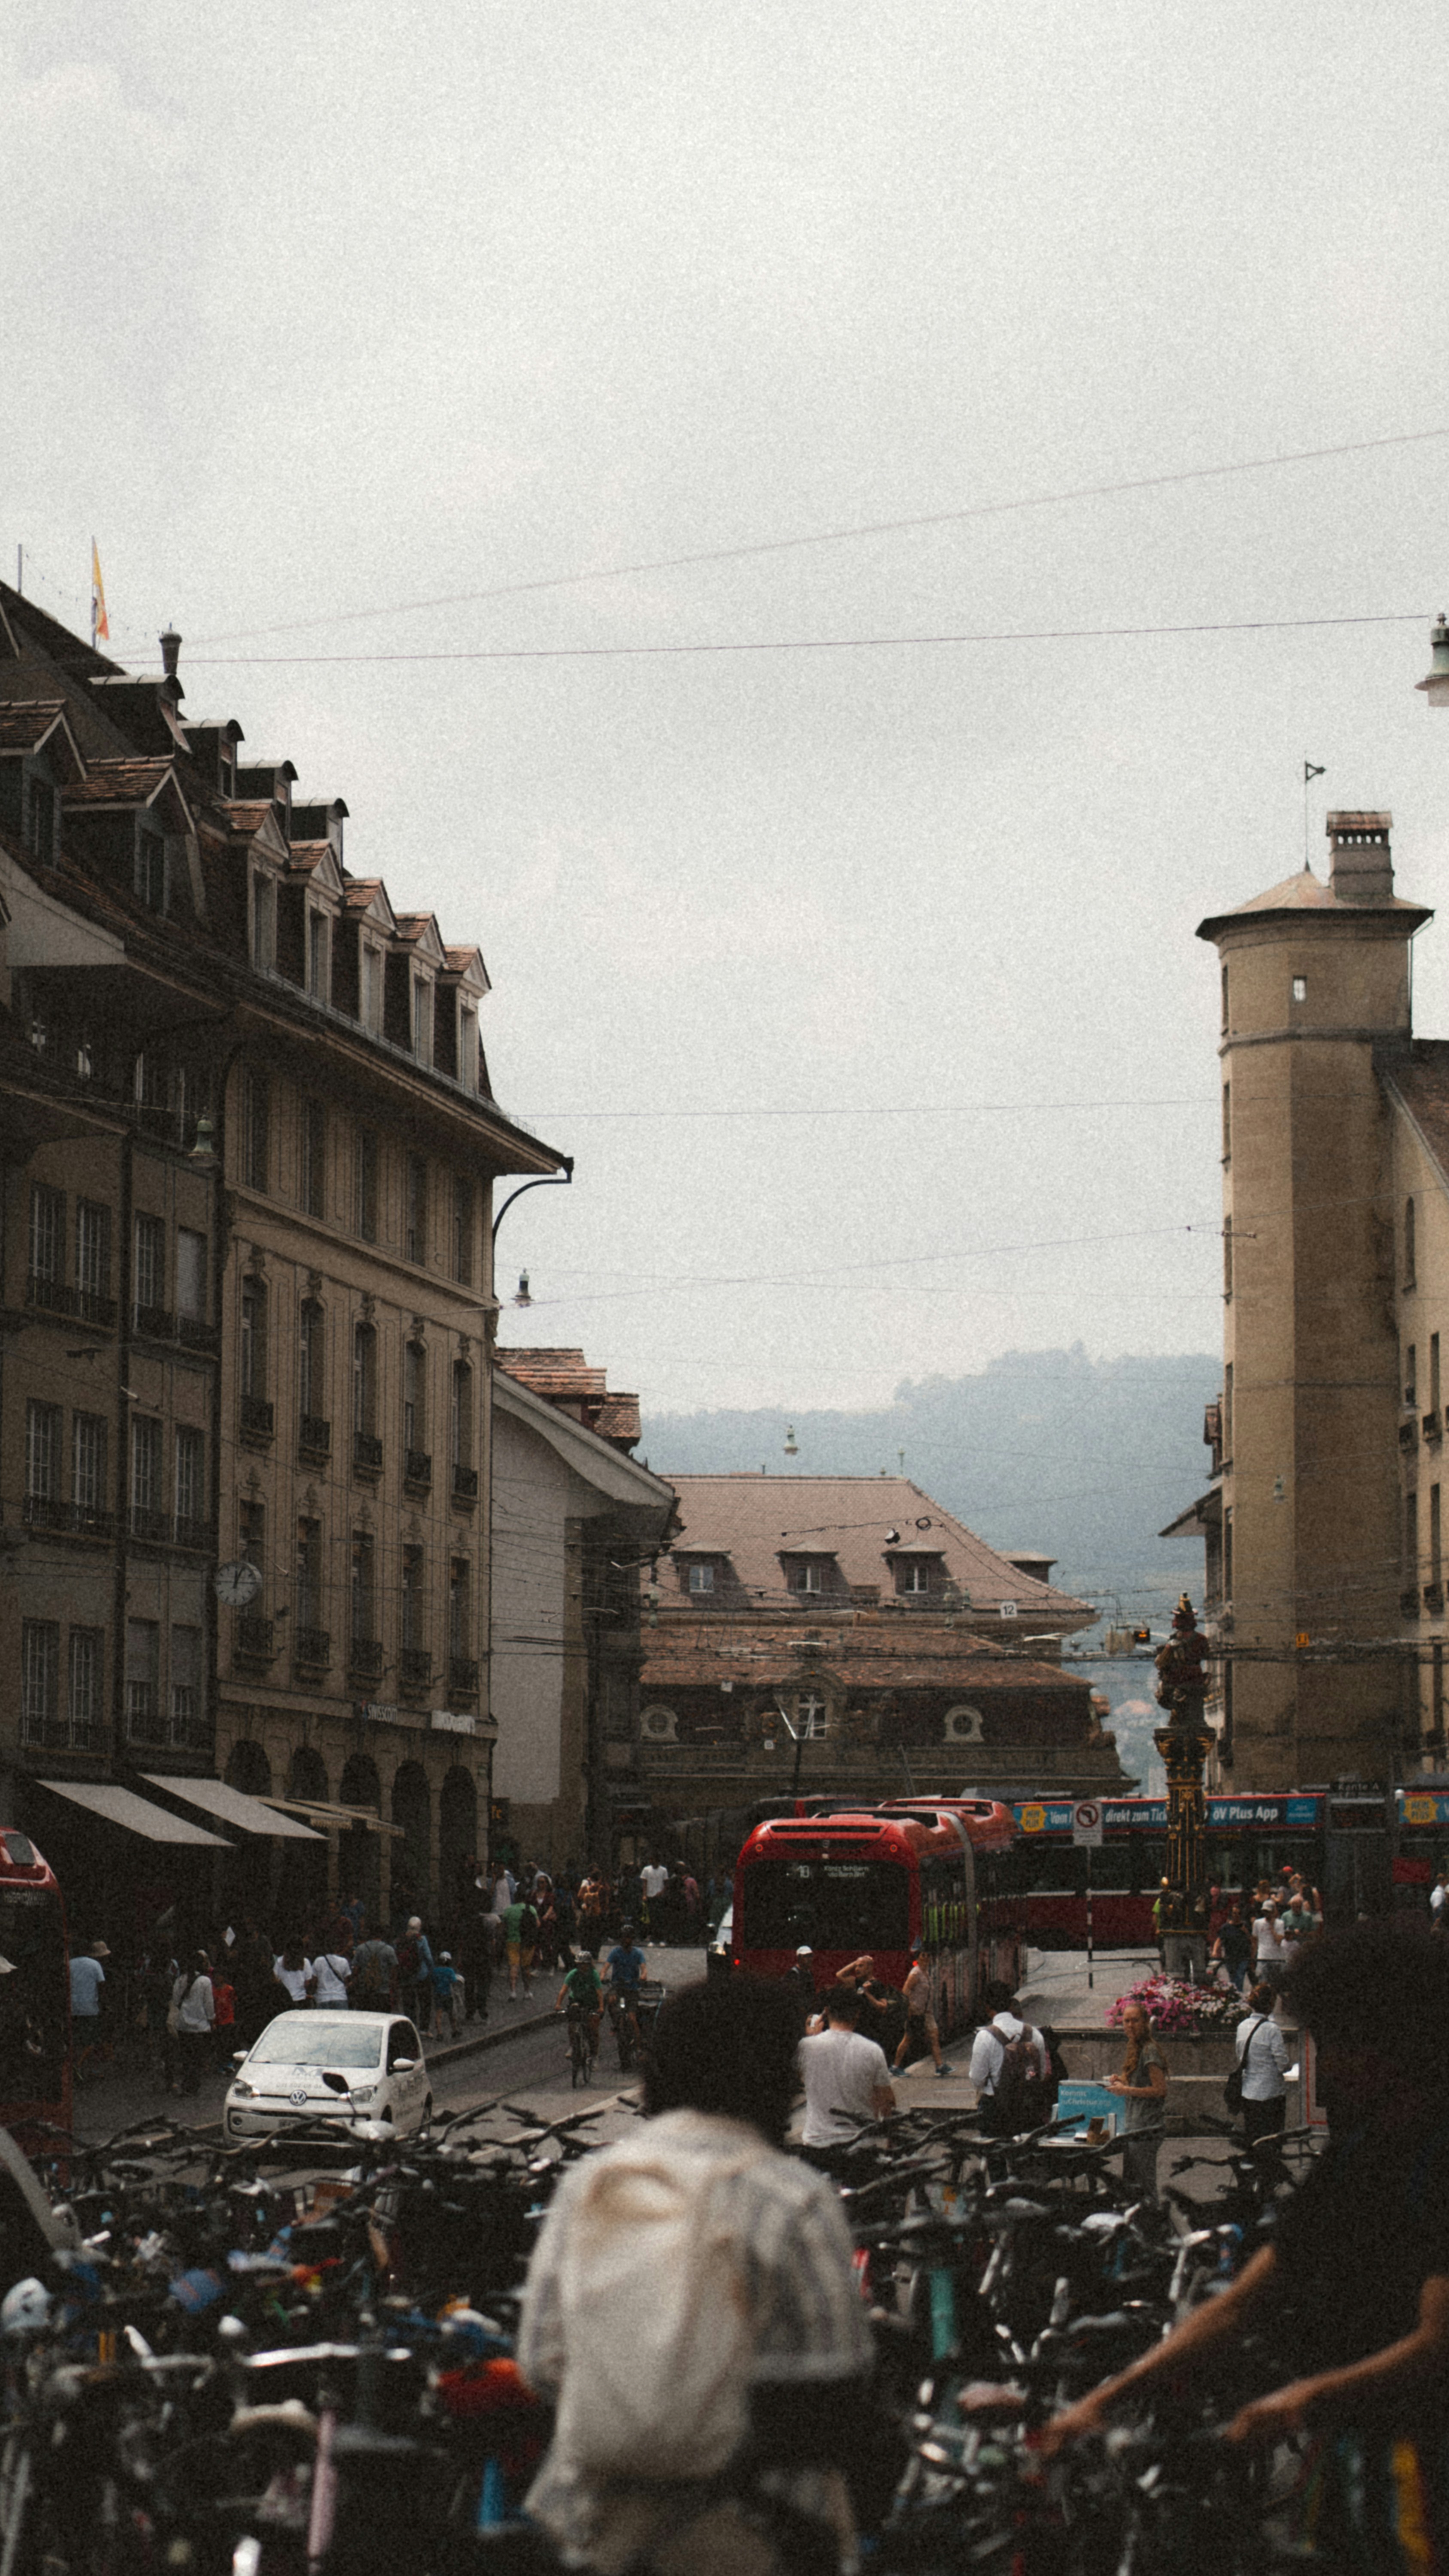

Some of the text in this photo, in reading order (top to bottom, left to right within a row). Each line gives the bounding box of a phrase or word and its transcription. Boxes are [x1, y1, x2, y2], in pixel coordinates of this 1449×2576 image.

[1003, 1605, 1015, 1615] 12
[1050, 1811, 1068, 1824] Vom
[1105, 1808, 1130, 1823] direkt
[1132, 1811, 1150, 1822] zum
[1213, 1806, 1228, 1820] öV
[1229, 1806, 1254, 1819] Plus
[1255, 1806, 1279, 1821] App
